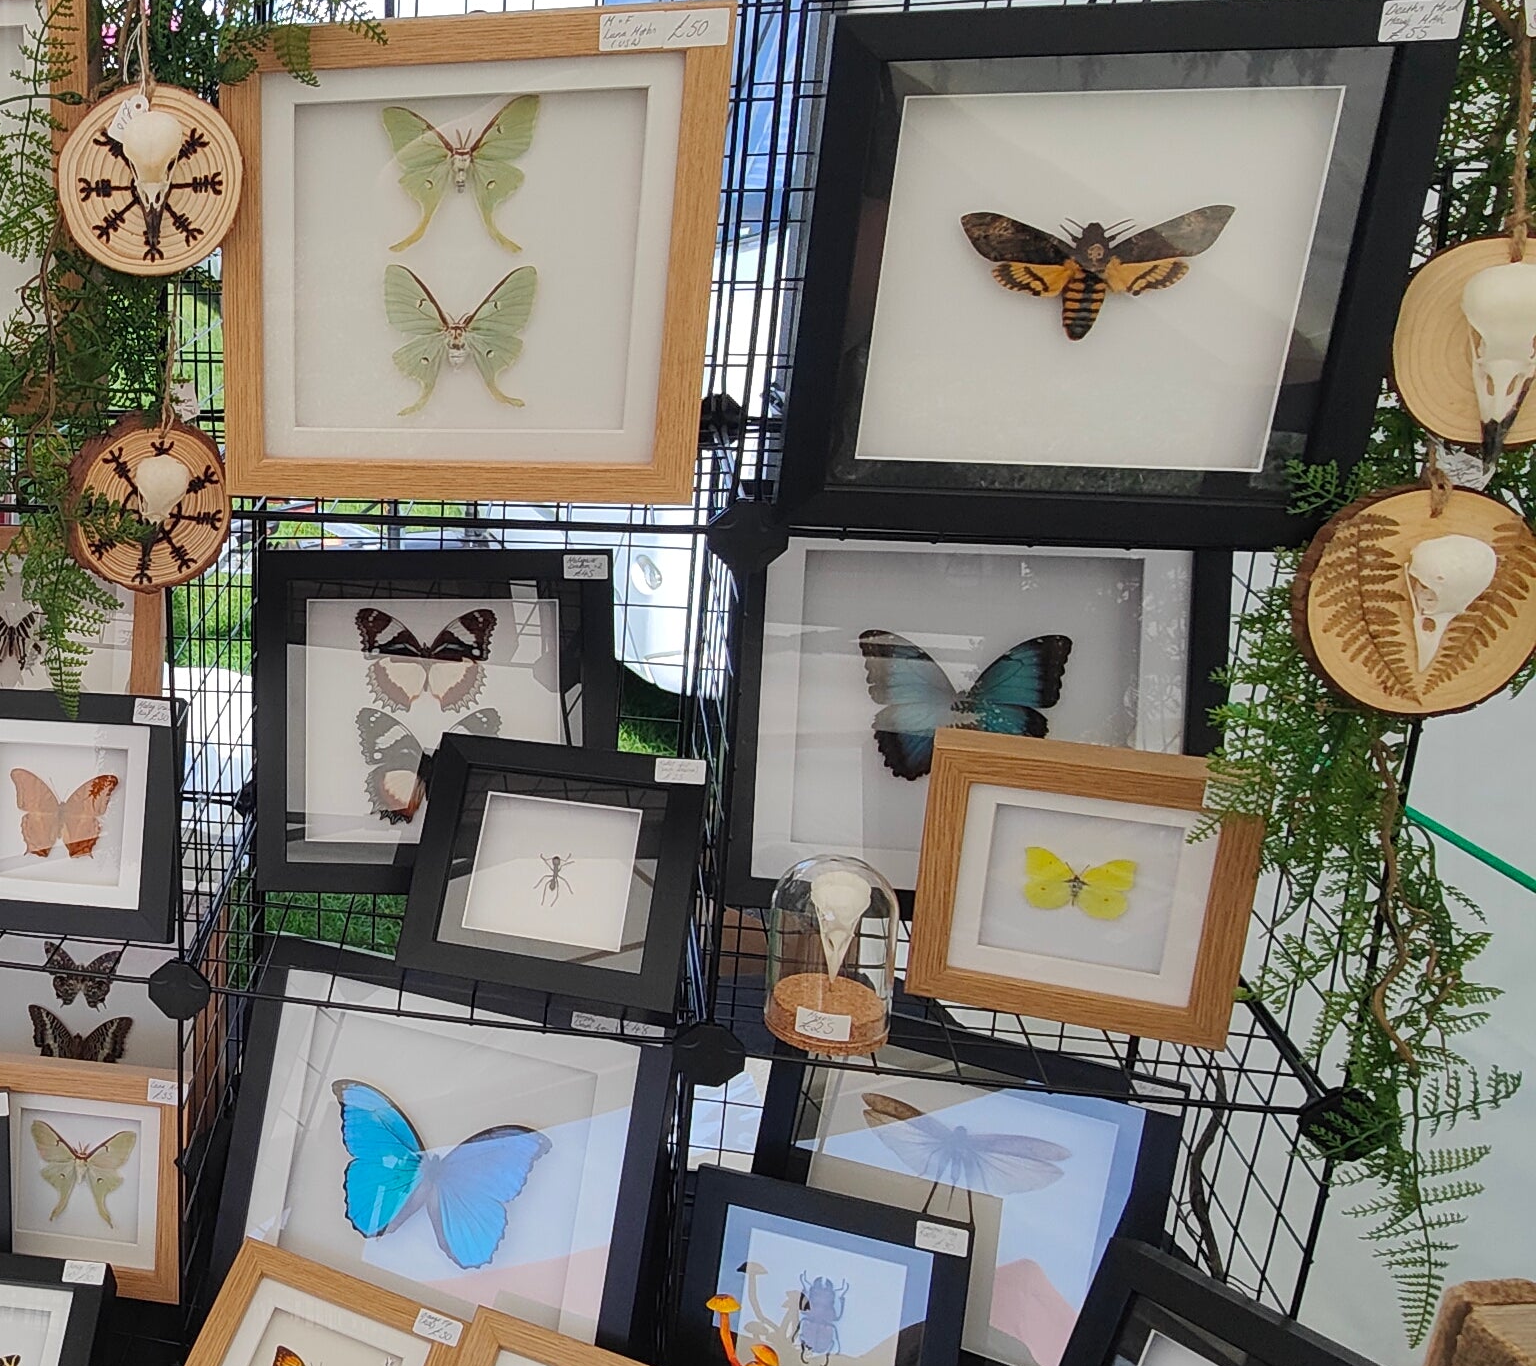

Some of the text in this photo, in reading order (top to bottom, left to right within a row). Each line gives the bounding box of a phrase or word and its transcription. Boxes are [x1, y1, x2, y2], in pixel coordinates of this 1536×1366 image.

[667, 13, 710, 42] £50
[1384, 24, 1430, 42] £55
[573, 569, 594, 578] £45
[798, 1018, 834, 1036] £25
[427, 1326, 453, 1341] £30
